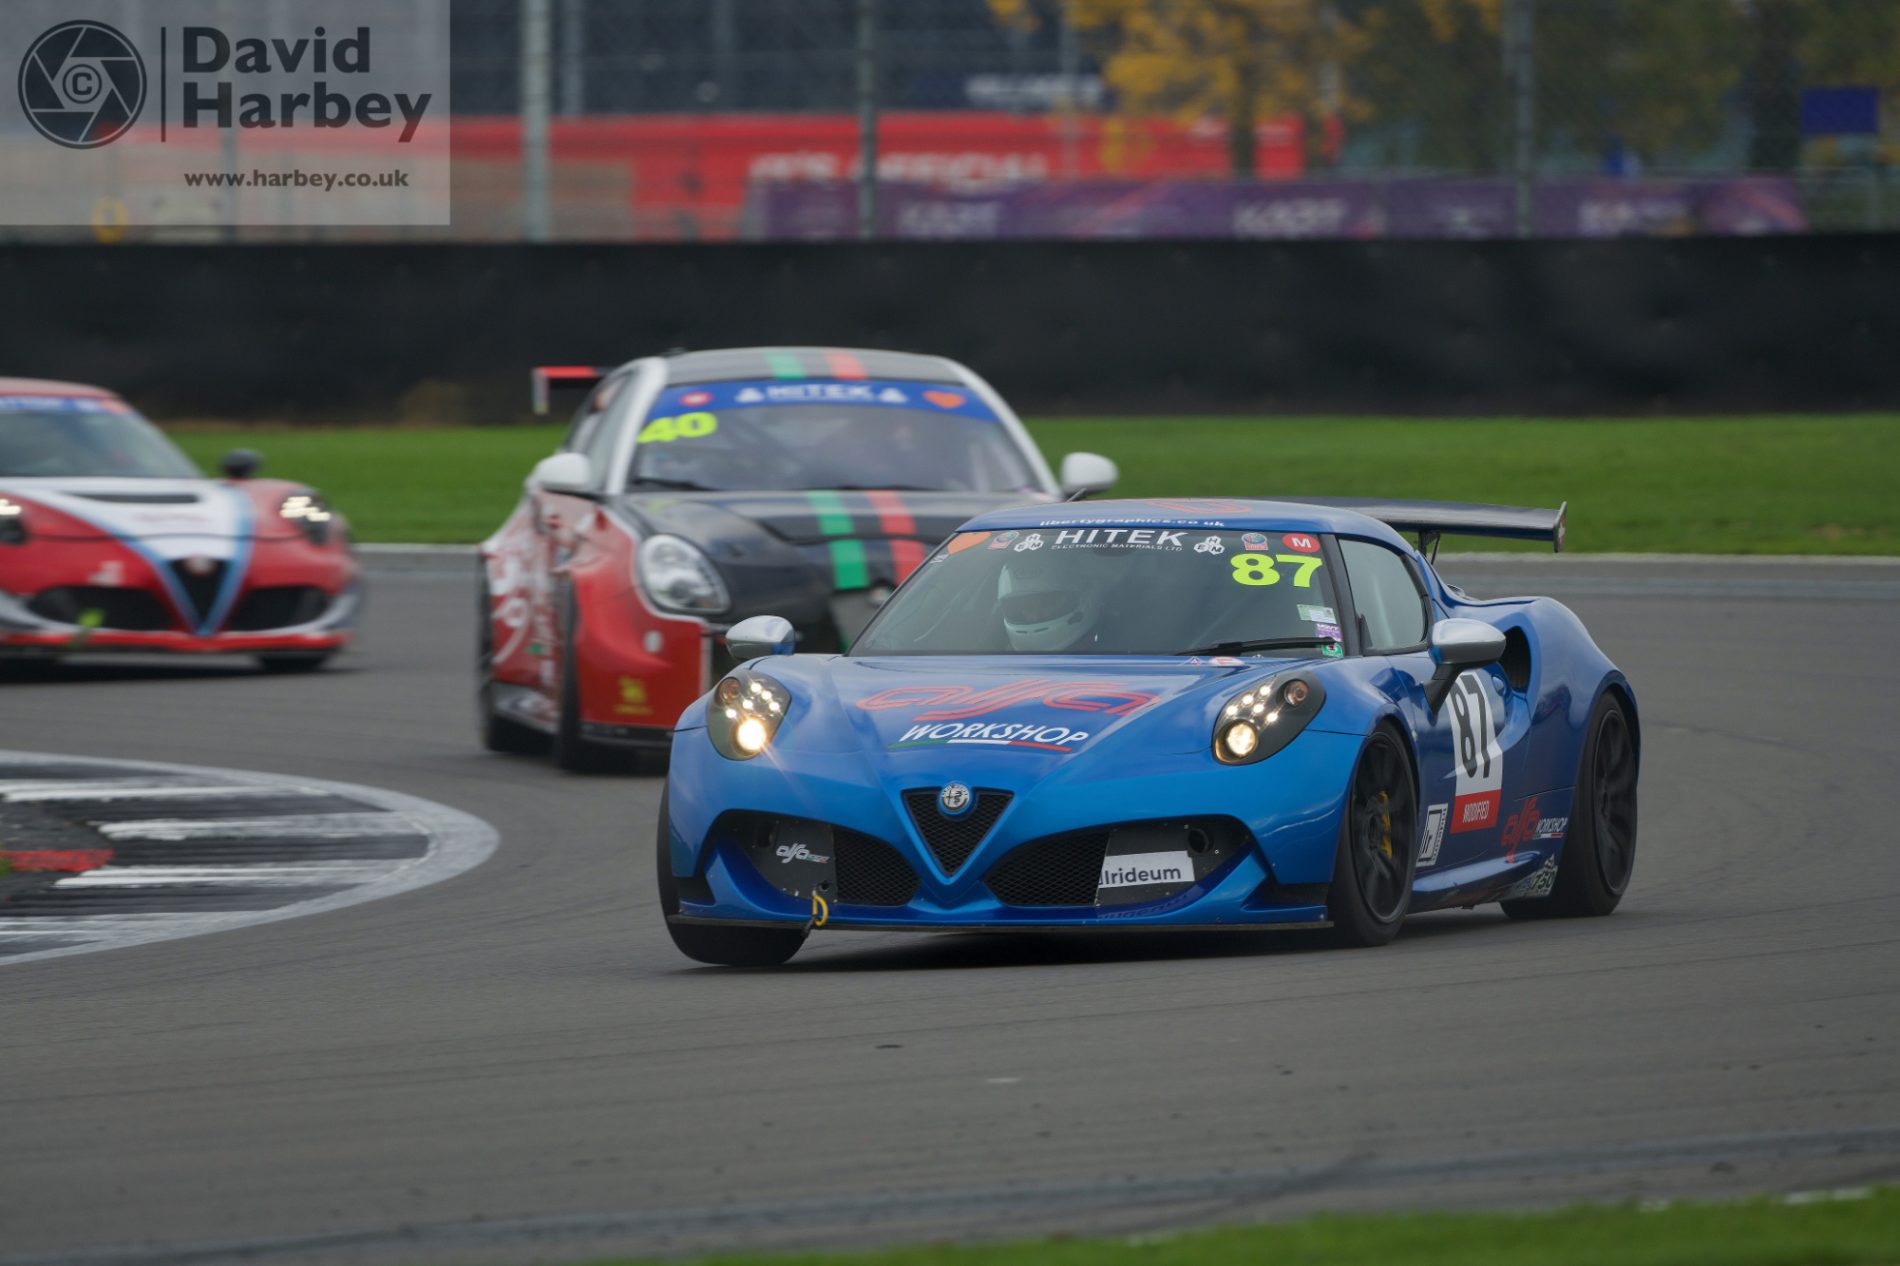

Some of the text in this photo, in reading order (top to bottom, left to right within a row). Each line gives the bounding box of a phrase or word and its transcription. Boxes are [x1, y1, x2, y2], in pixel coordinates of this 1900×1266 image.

[766, 384, 875, 400] HITEK
[637, 411, 718, 444] 40
[1055, 529, 1189, 547] HITEK
[1111, 543, 1163, 551] MATERIALS
[1291, 537, 1312, 549] M
[1230, 553, 1323, 588] 87
[899, 723, 1089, 744] WORKSHOP
[1451, 674, 1491, 779] 87
[1462, 800, 1490, 824] MODIFIED
